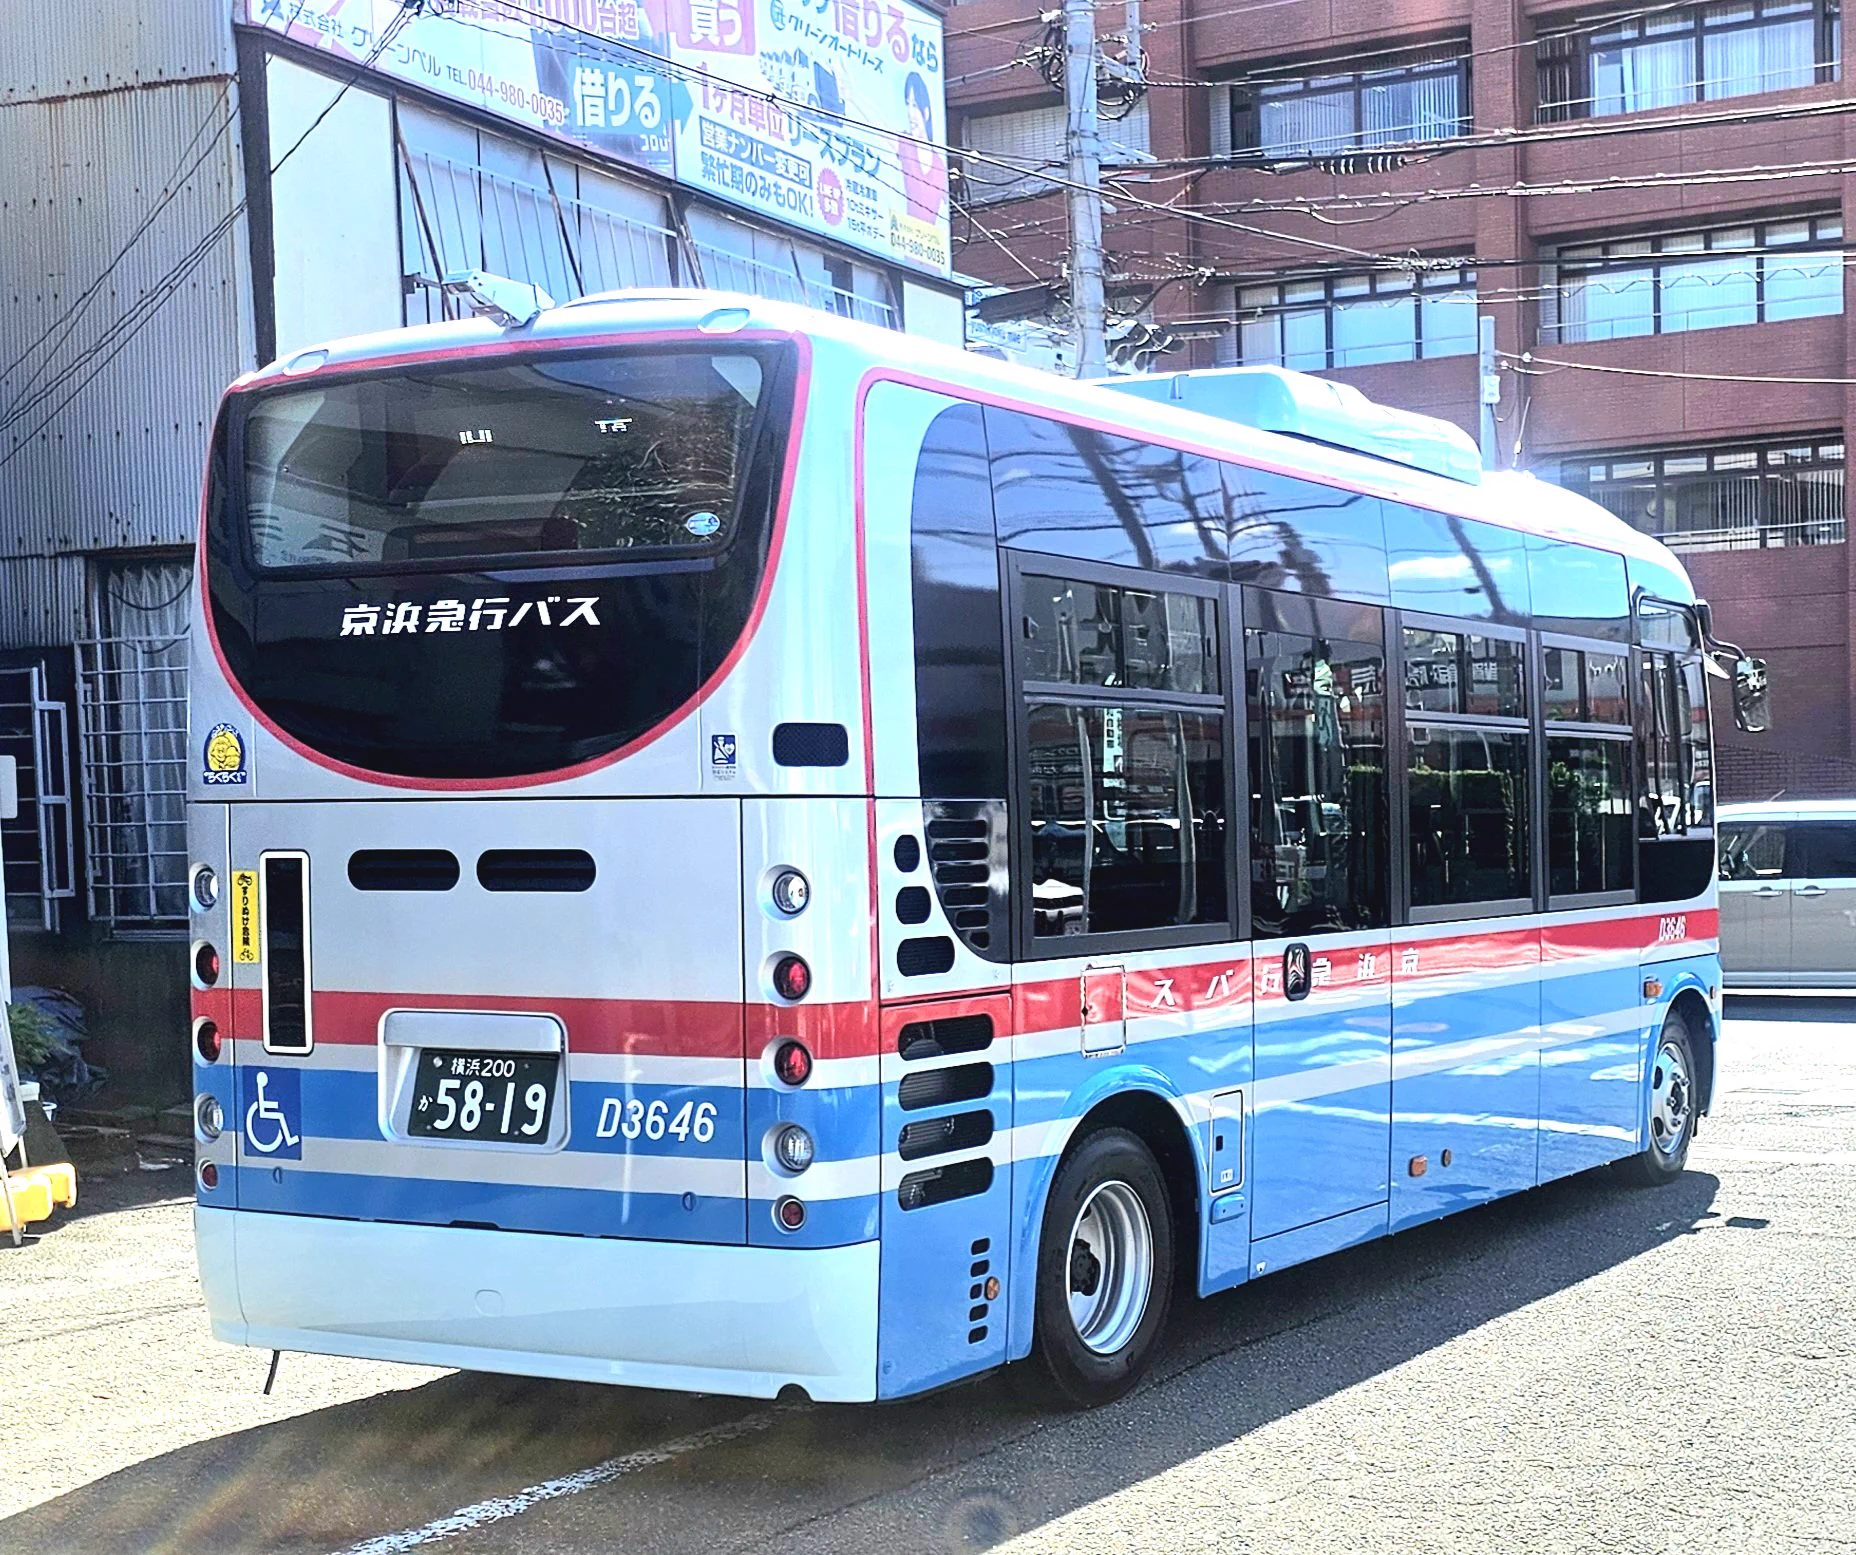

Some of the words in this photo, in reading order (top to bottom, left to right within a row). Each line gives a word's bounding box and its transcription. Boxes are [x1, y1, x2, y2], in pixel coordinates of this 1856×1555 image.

[573, 66, 661, 129] 借りる
[340, 596, 600, 636] 京浜急行バス
[418, 1094, 433, 1112] か
[433, 1079, 547, 1136] 58-19
[596, 1097, 718, 1143] D3646
